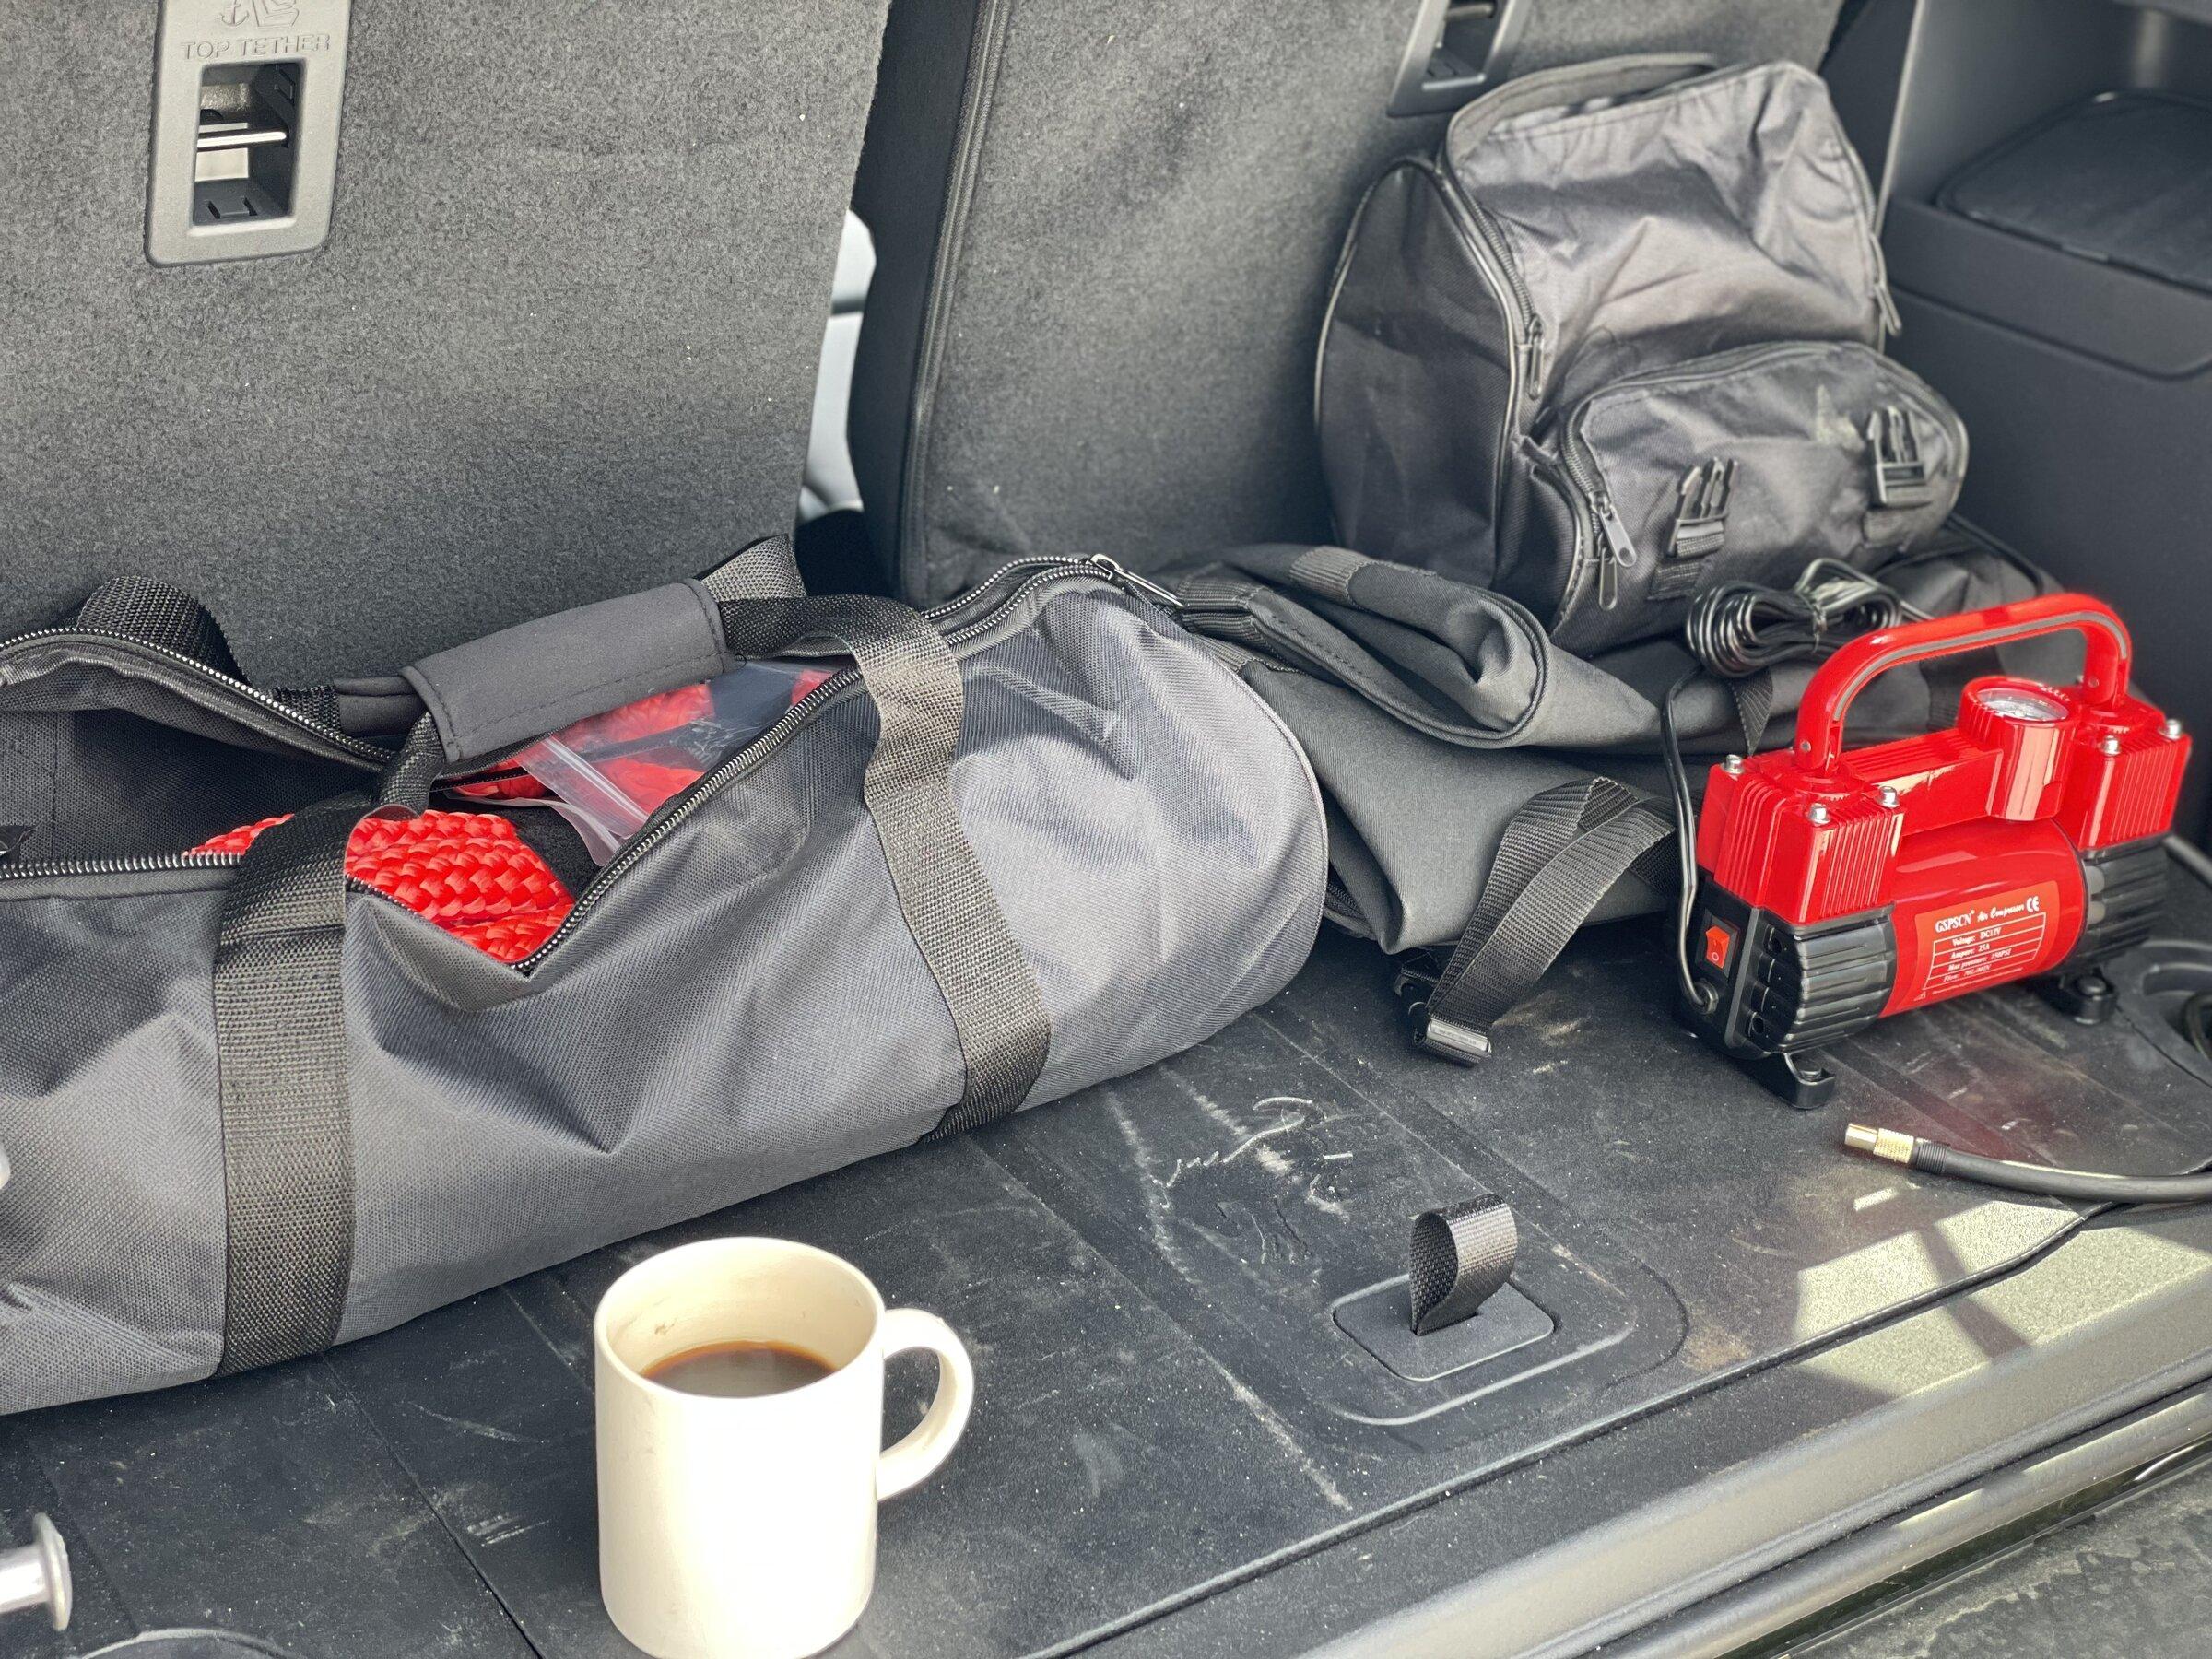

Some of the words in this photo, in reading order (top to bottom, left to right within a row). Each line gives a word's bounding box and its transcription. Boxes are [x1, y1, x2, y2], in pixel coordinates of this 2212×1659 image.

[181, 40, 230, 59] TOP
[236, 33, 330, 56] TETHER
[2026, 896, 2039, 912] CE
[1980, 927, 2002, 939] DC12V
[1978, 943, 1990, 952] 25A
